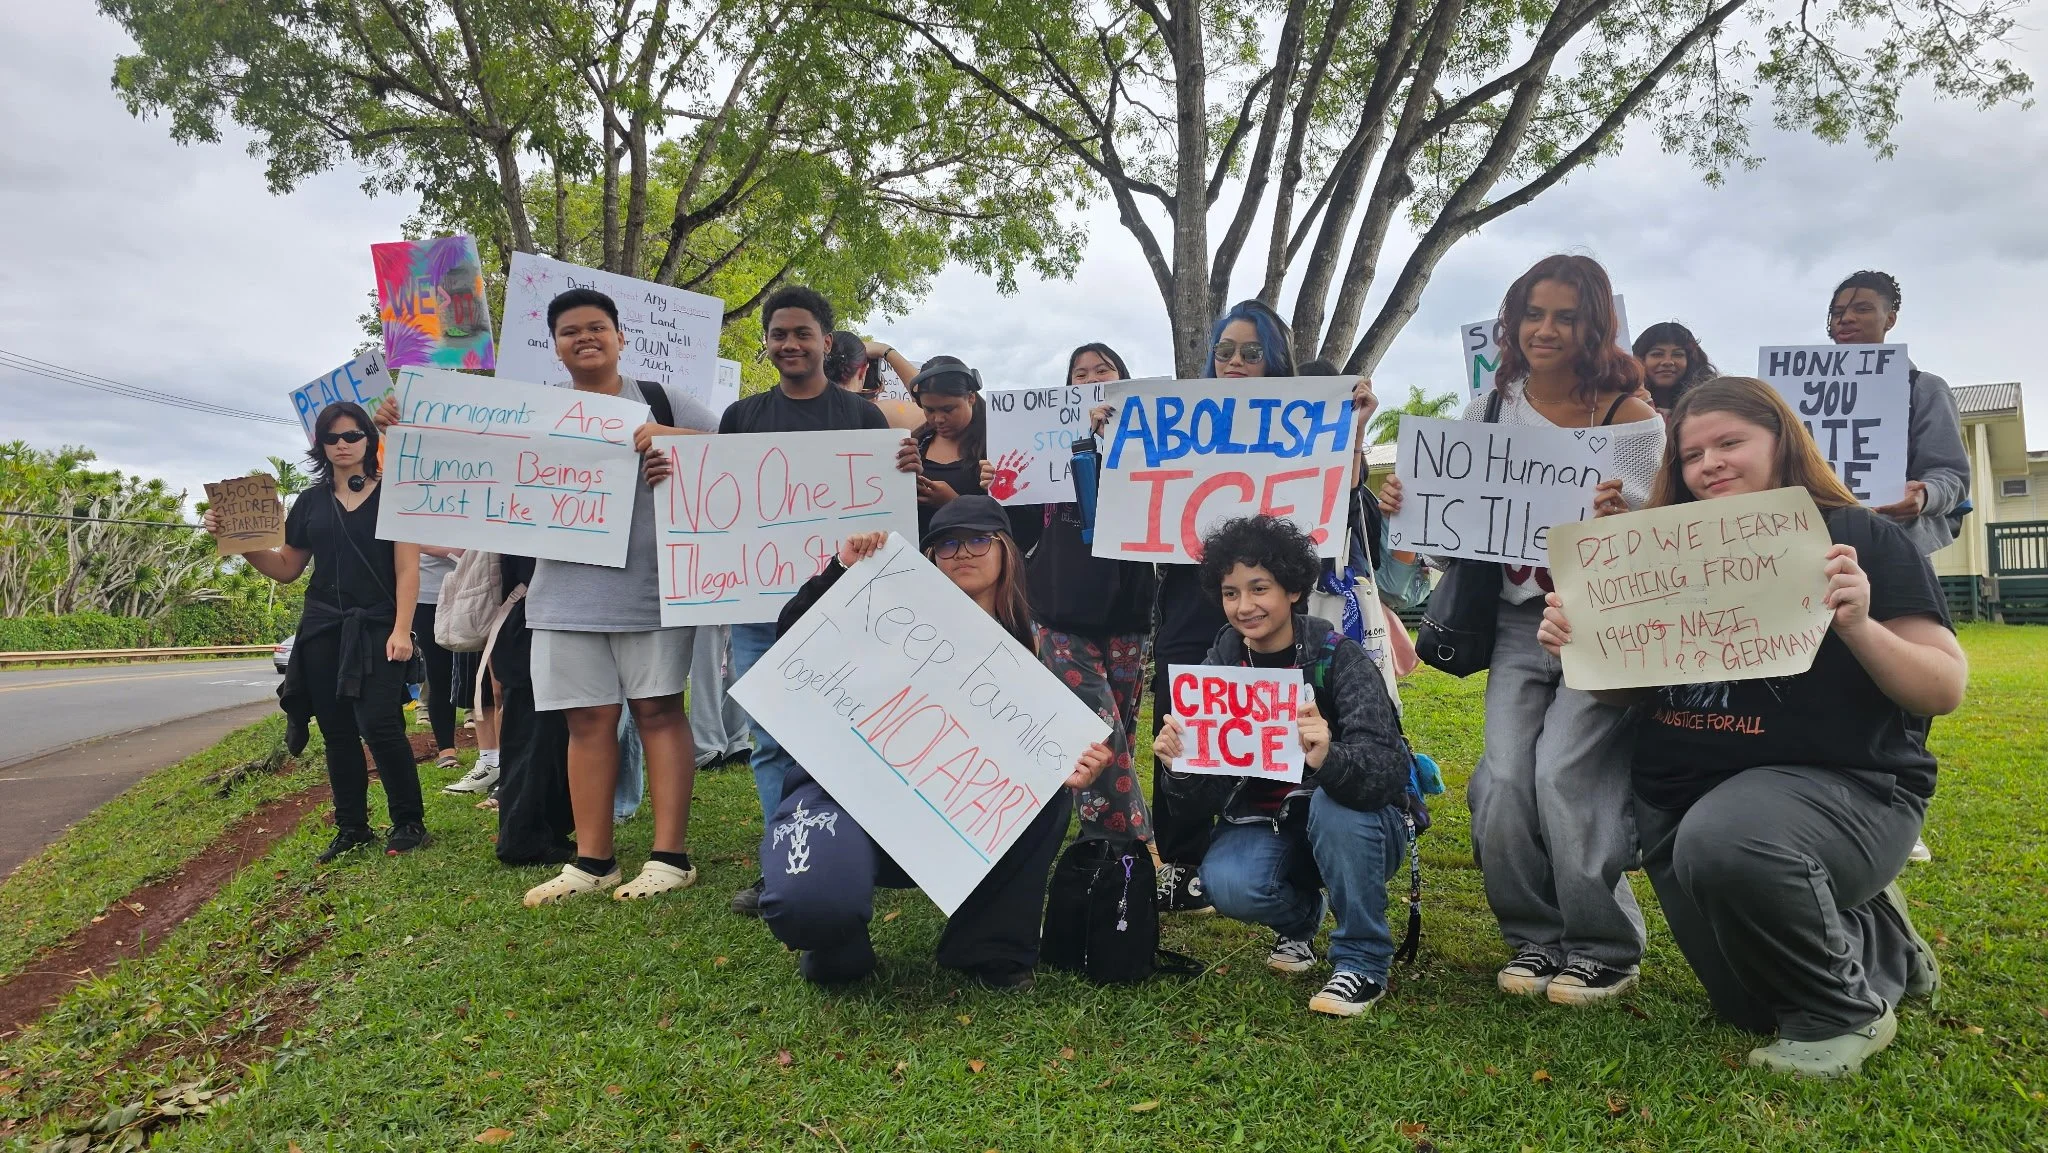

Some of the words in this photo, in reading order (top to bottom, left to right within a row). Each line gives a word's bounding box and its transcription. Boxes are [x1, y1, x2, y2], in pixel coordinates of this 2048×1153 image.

[383, 274, 435, 317] WE
[644, 293, 667, 312] Any
[528, 337, 549, 349] and
[635, 337, 669, 356] OWN
[667, 332, 691, 347] Well
[1769, 350, 1850, 377] HONK
[1855, 350, 1896, 375] IF
[294, 360, 371, 432] PEACE
[365, 355, 380, 376] and
[398, 371, 536, 434] Immigrants
[555, 401, 625, 444] Are
[992, 393, 1015, 412] NO
[1024, 389, 1058, 410] ONE
[1066, 386, 1081, 405] IS
[1060, 407, 1080, 425] ON
[1799, 381, 1858, 417] YOU
[1106, 396, 1353, 470] ABOLISH
[398, 432, 493, 482] Human
[517, 451, 604, 494] Beings
[758, 447, 836, 522] One
[836, 454, 884, 510] Is
[1049, 460, 1072, 482] LA
[1486, 433, 1602, 488] Human
[210, 479, 275, 504] 5,500+
[403, 484, 470, 515] Just
[486, 487, 533, 521] Like
[1121, 466, 1345, 562] ICE!
[1411, 492, 1465, 551] IS
[1576, 529, 1642, 568] DID
[1653, 521, 1703, 552] WE
[1721, 511, 1810, 546] LEARN
[665, 543, 748, 602] Illegal
[756, 542, 794, 586] On
[1587, 567, 1687, 609] NOTHING
[1704, 555, 1778, 587] FROM
[1681, 607, 1752, 638] NAZI
[845, 546, 955, 678] Keep
[959, 641, 1068, 771] Families
[1172, 673, 1298, 722] CRUSH
[1662, 709, 1704, 730] JUSTICE
[1707, 714, 1733, 732] FOR
[1736, 716, 1765, 735] ALL
[857, 685, 970, 777] NOT
[917, 746, 1041, 855] APART
[1185, 717, 1289, 772] ICE
